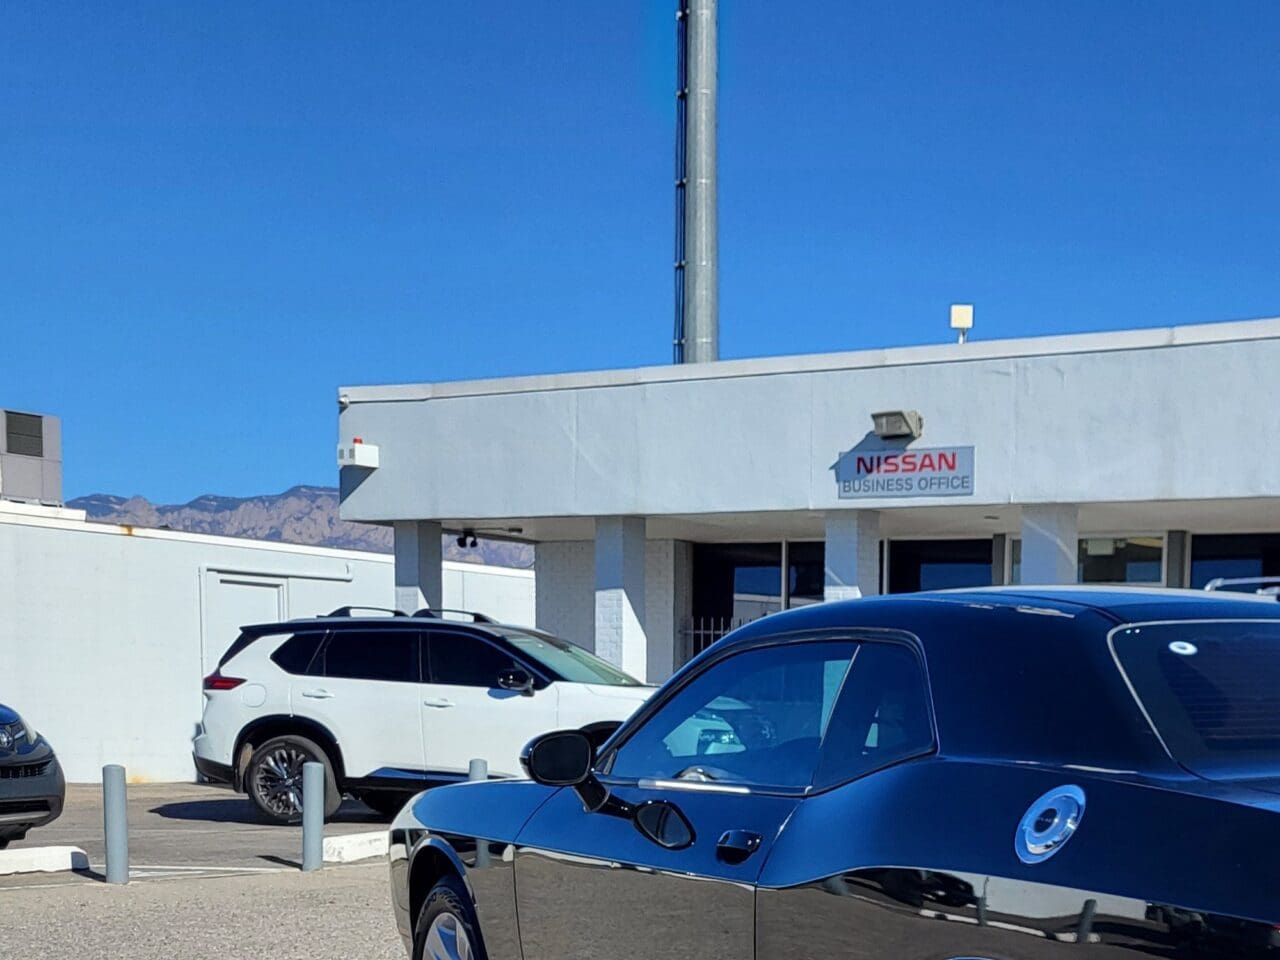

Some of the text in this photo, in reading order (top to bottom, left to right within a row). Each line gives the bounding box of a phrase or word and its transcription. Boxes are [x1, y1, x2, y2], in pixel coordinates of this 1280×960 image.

[856, 452, 957, 474] NISSAN
[842, 475, 970, 493] BUSINESS OFFICE
